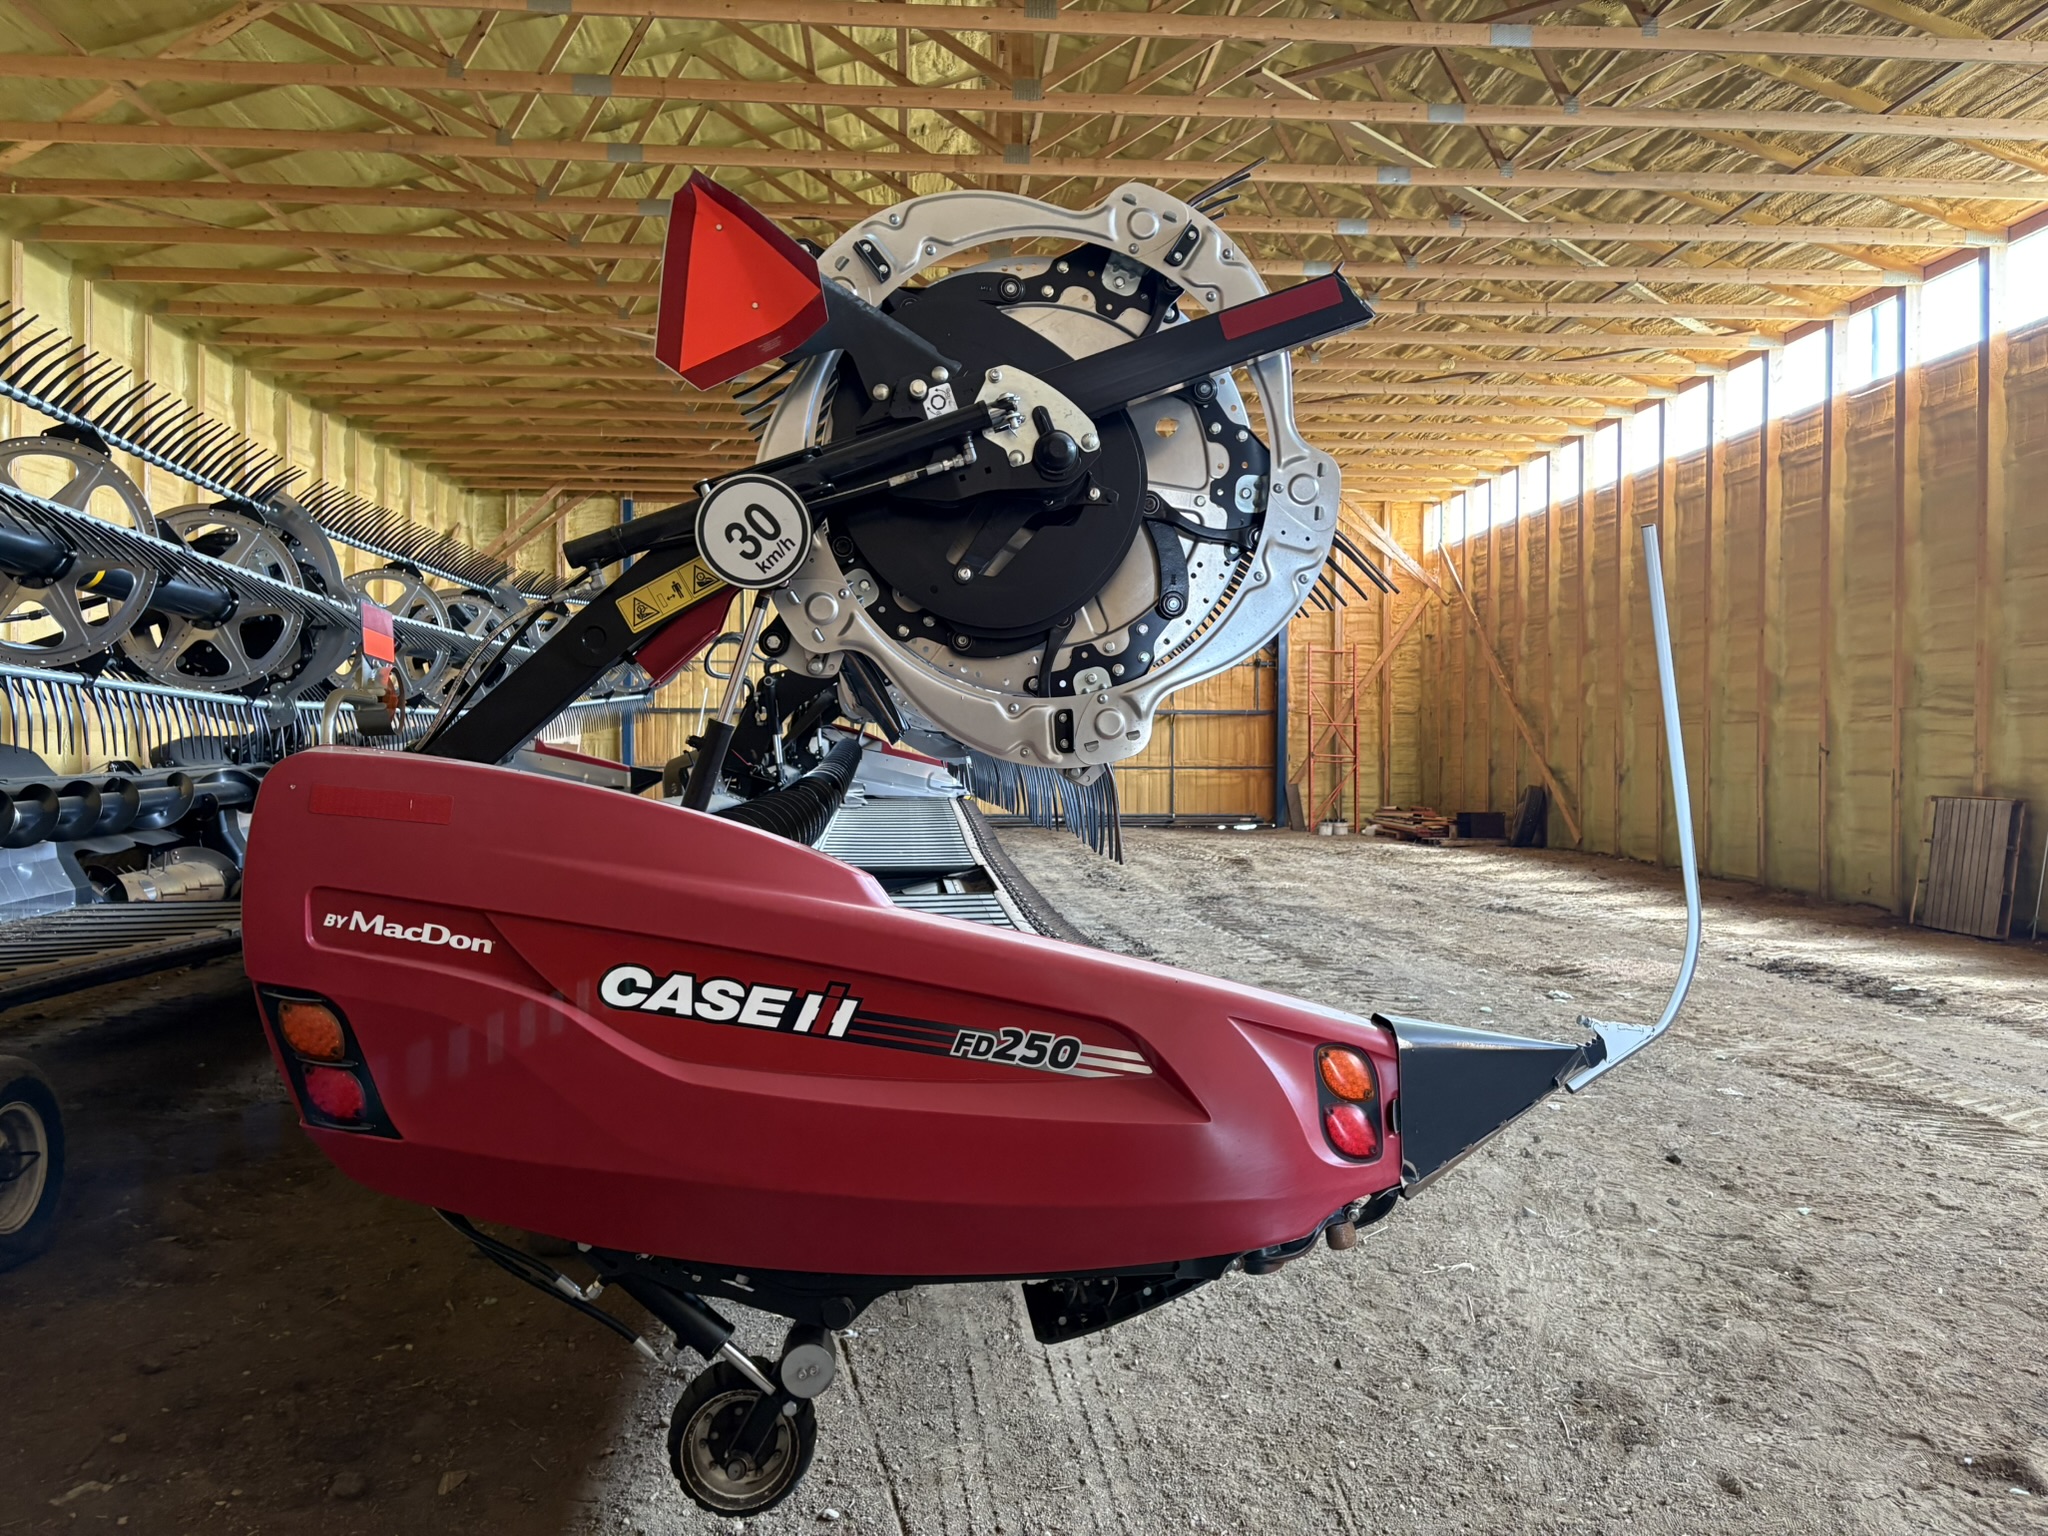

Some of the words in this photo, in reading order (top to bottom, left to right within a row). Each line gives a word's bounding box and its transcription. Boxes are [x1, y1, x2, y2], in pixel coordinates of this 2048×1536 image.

[725, 503, 782, 560] 30
[755, 538, 796, 574] km/h
[323, 913, 349, 929] BY
[348, 910, 493, 954] MacDon
[600, 965, 794, 1029] CASE
[951, 1027, 1082, 1071] FD250
